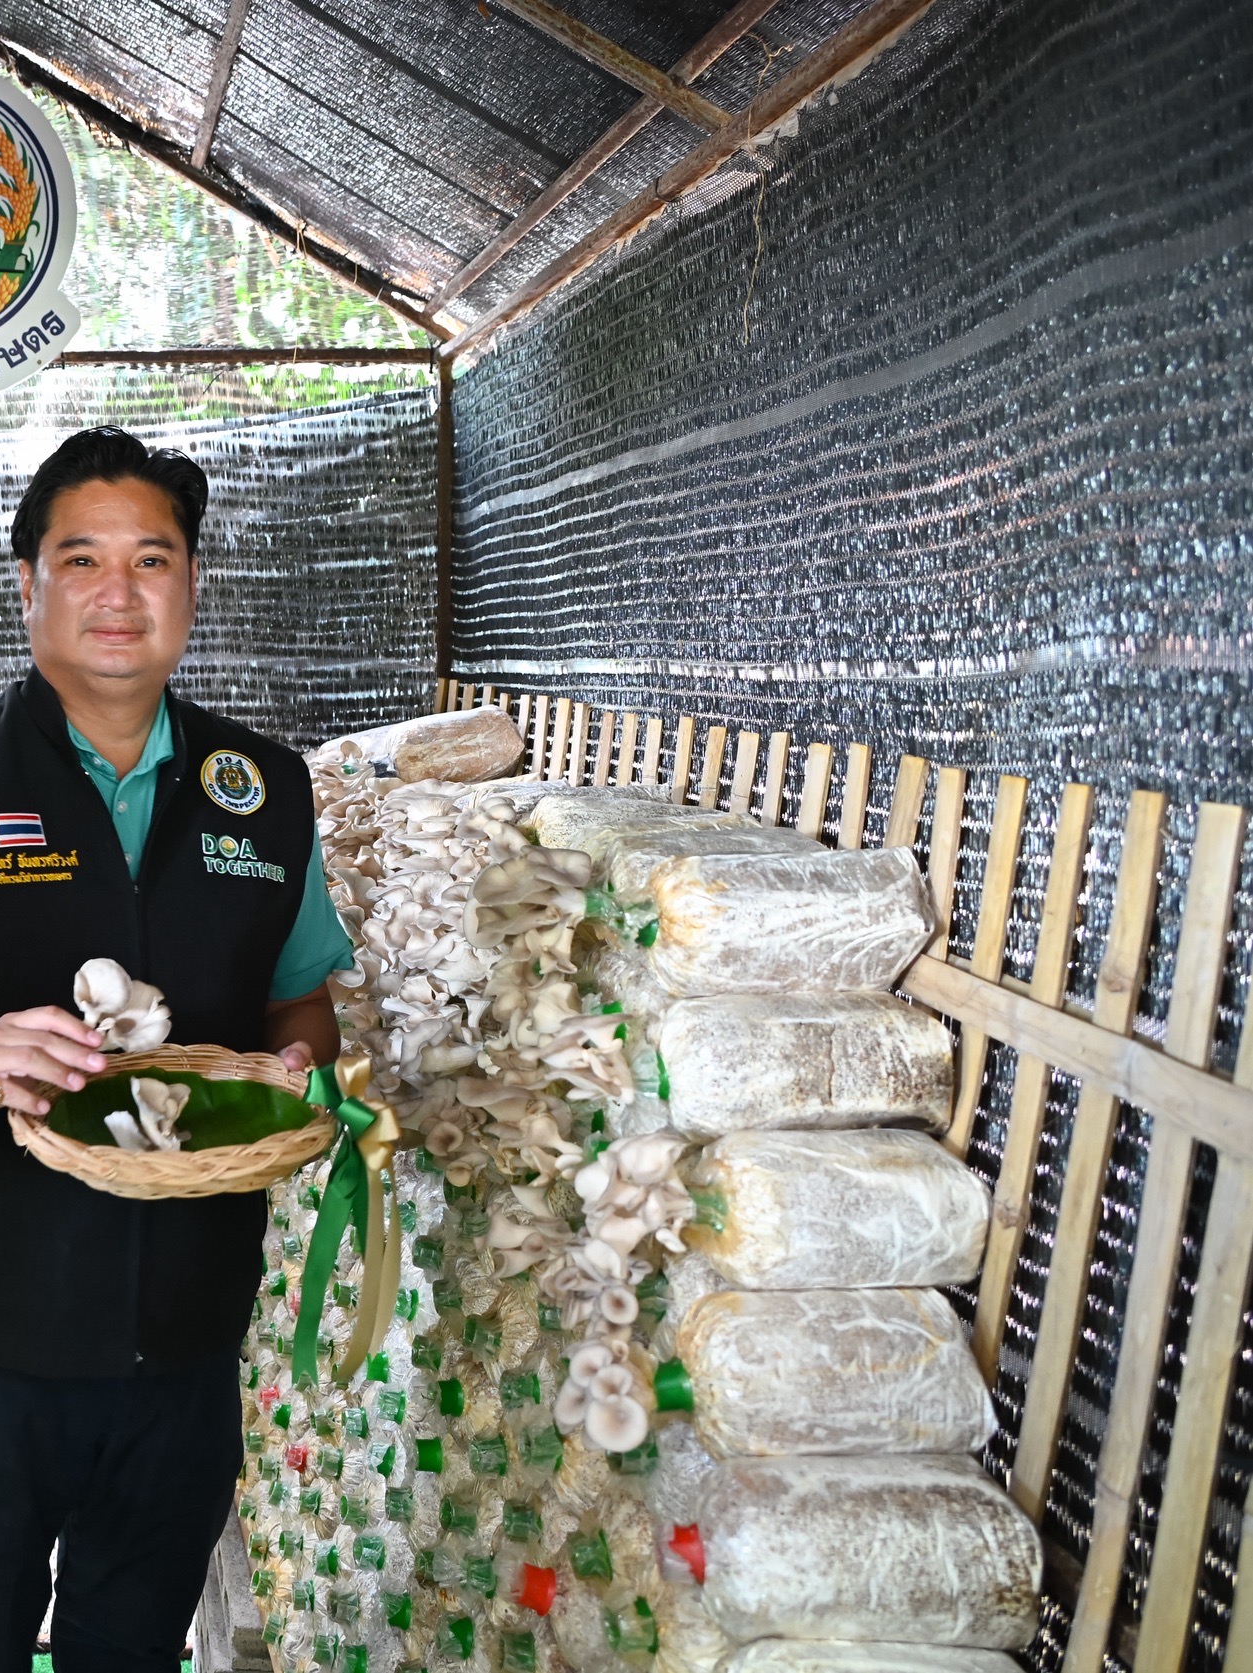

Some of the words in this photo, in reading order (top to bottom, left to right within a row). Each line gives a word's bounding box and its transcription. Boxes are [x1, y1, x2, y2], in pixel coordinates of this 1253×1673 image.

[215, 756, 244, 767] DOA
[225, 786, 260, 809] INSPECTOR
[201, 833, 258, 860] DOA
[203, 856, 286, 882] TOGETHER
